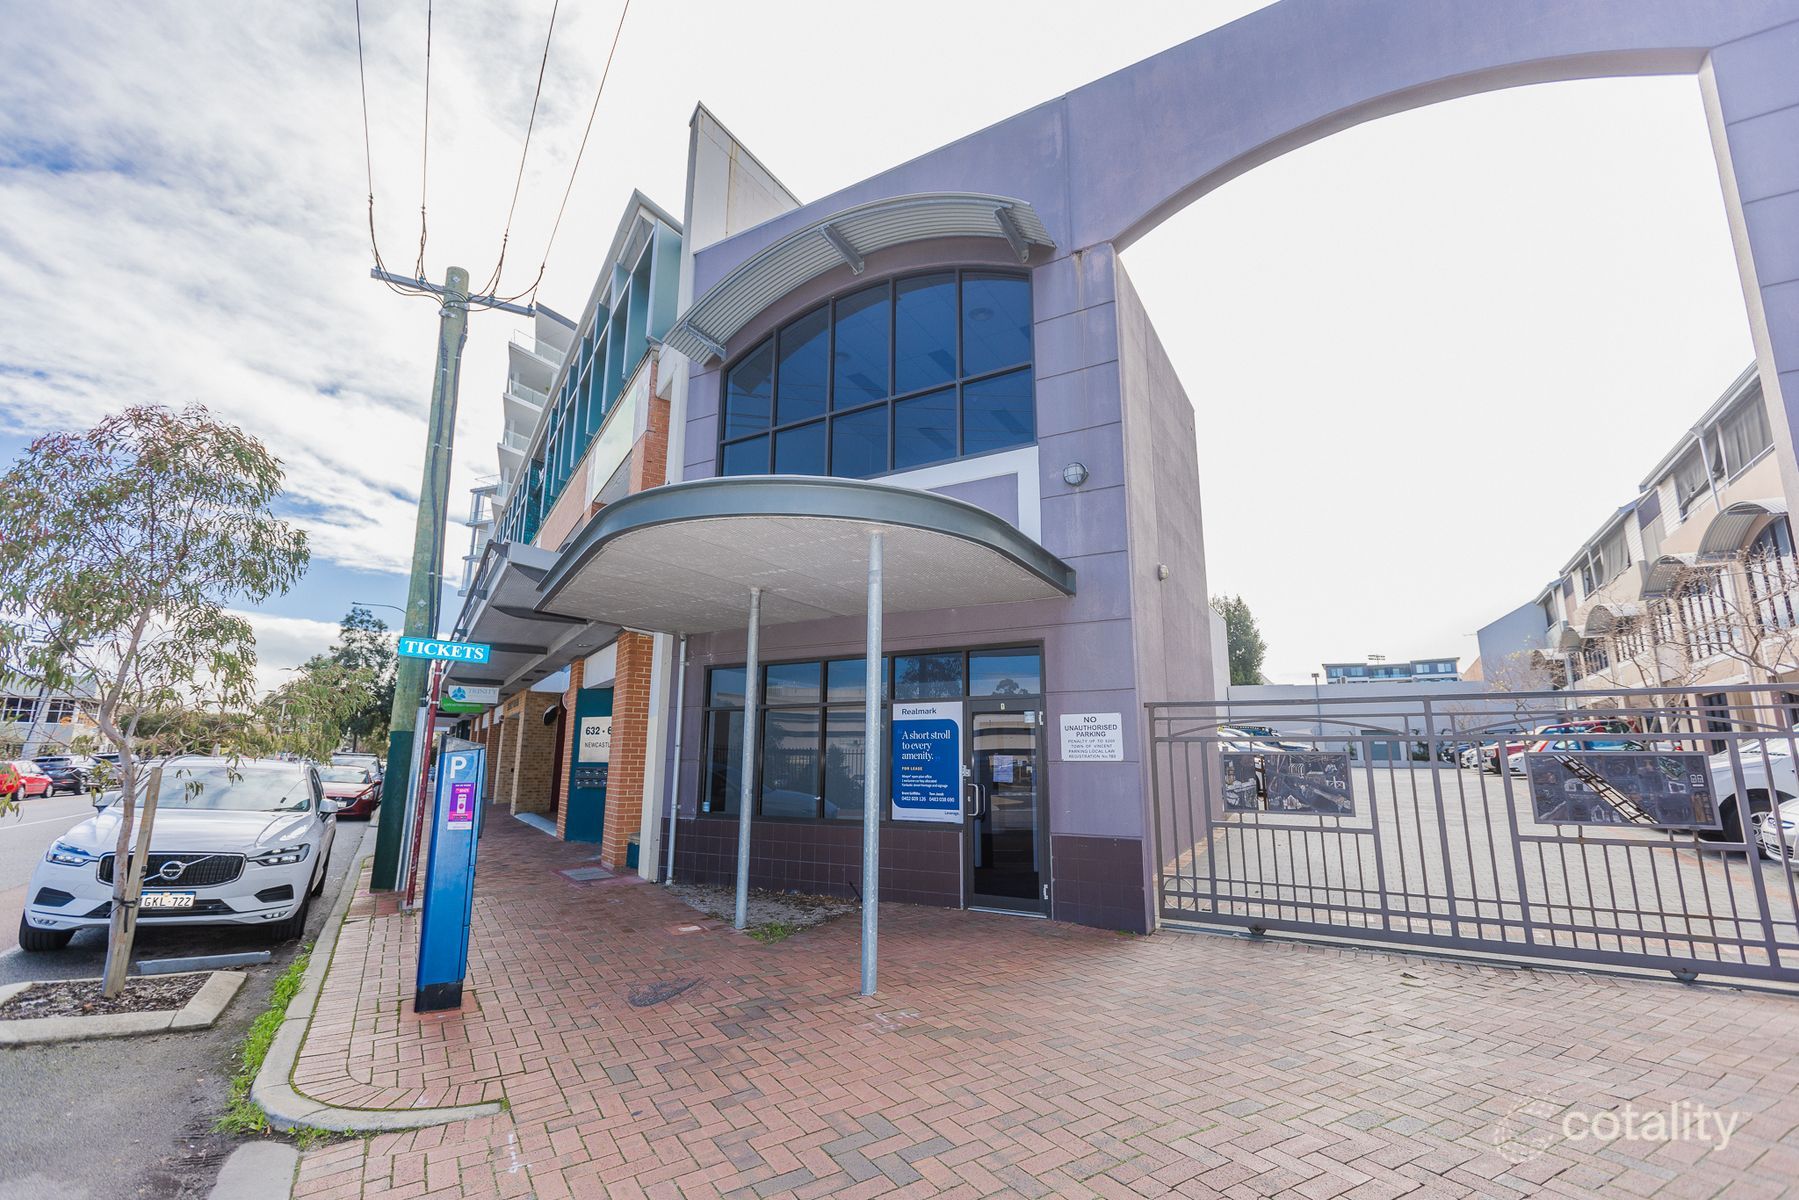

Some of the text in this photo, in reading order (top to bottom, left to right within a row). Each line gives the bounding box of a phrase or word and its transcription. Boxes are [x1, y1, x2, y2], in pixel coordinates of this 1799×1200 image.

[405, 640, 484, 660] TICKETS
[901, 707, 937, 715] Realmark
[585, 726, 600, 735] 632
[901, 729, 951, 740] A short stroll
[902, 742, 932, 751] to every
[901, 751, 934, 761] amenity.
[450, 756, 467, 779] P
